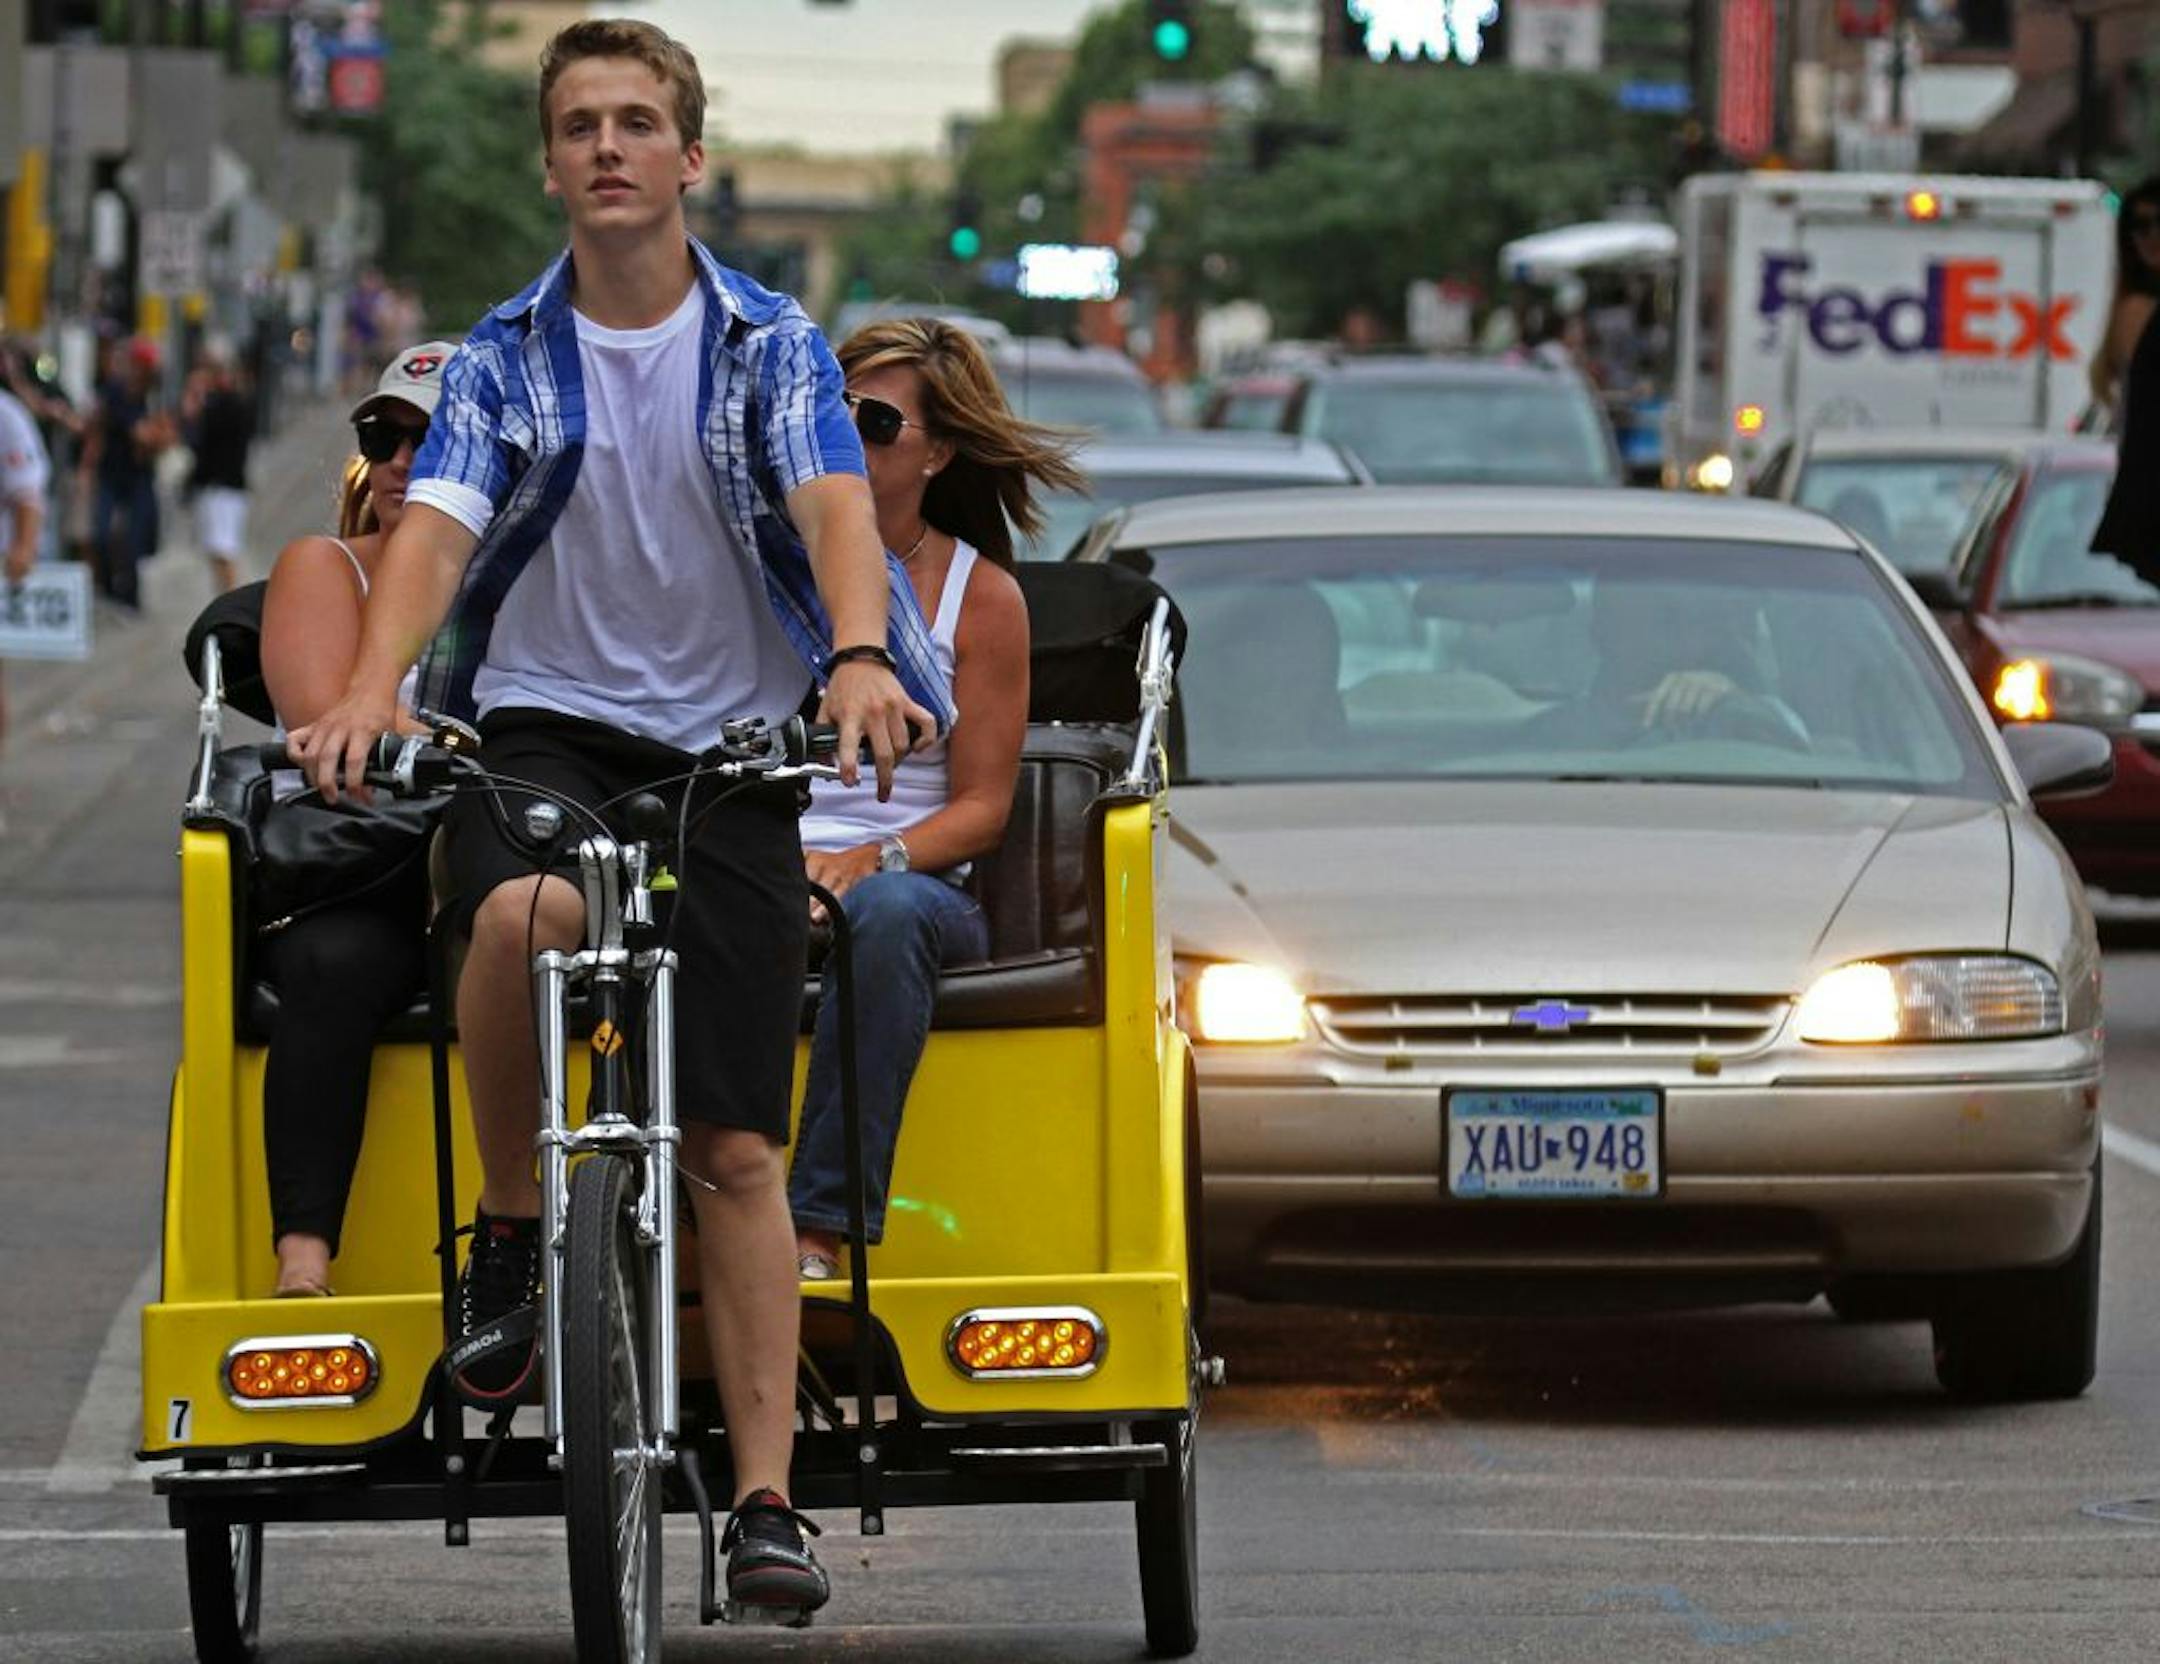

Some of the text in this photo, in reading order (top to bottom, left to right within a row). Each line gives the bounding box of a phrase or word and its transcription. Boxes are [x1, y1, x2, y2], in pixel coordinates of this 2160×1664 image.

[1759, 252, 2082, 360] FedEx
[1512, 1096, 1605, 1115] Minnesota
[172, 1400, 189, 1438] 7
